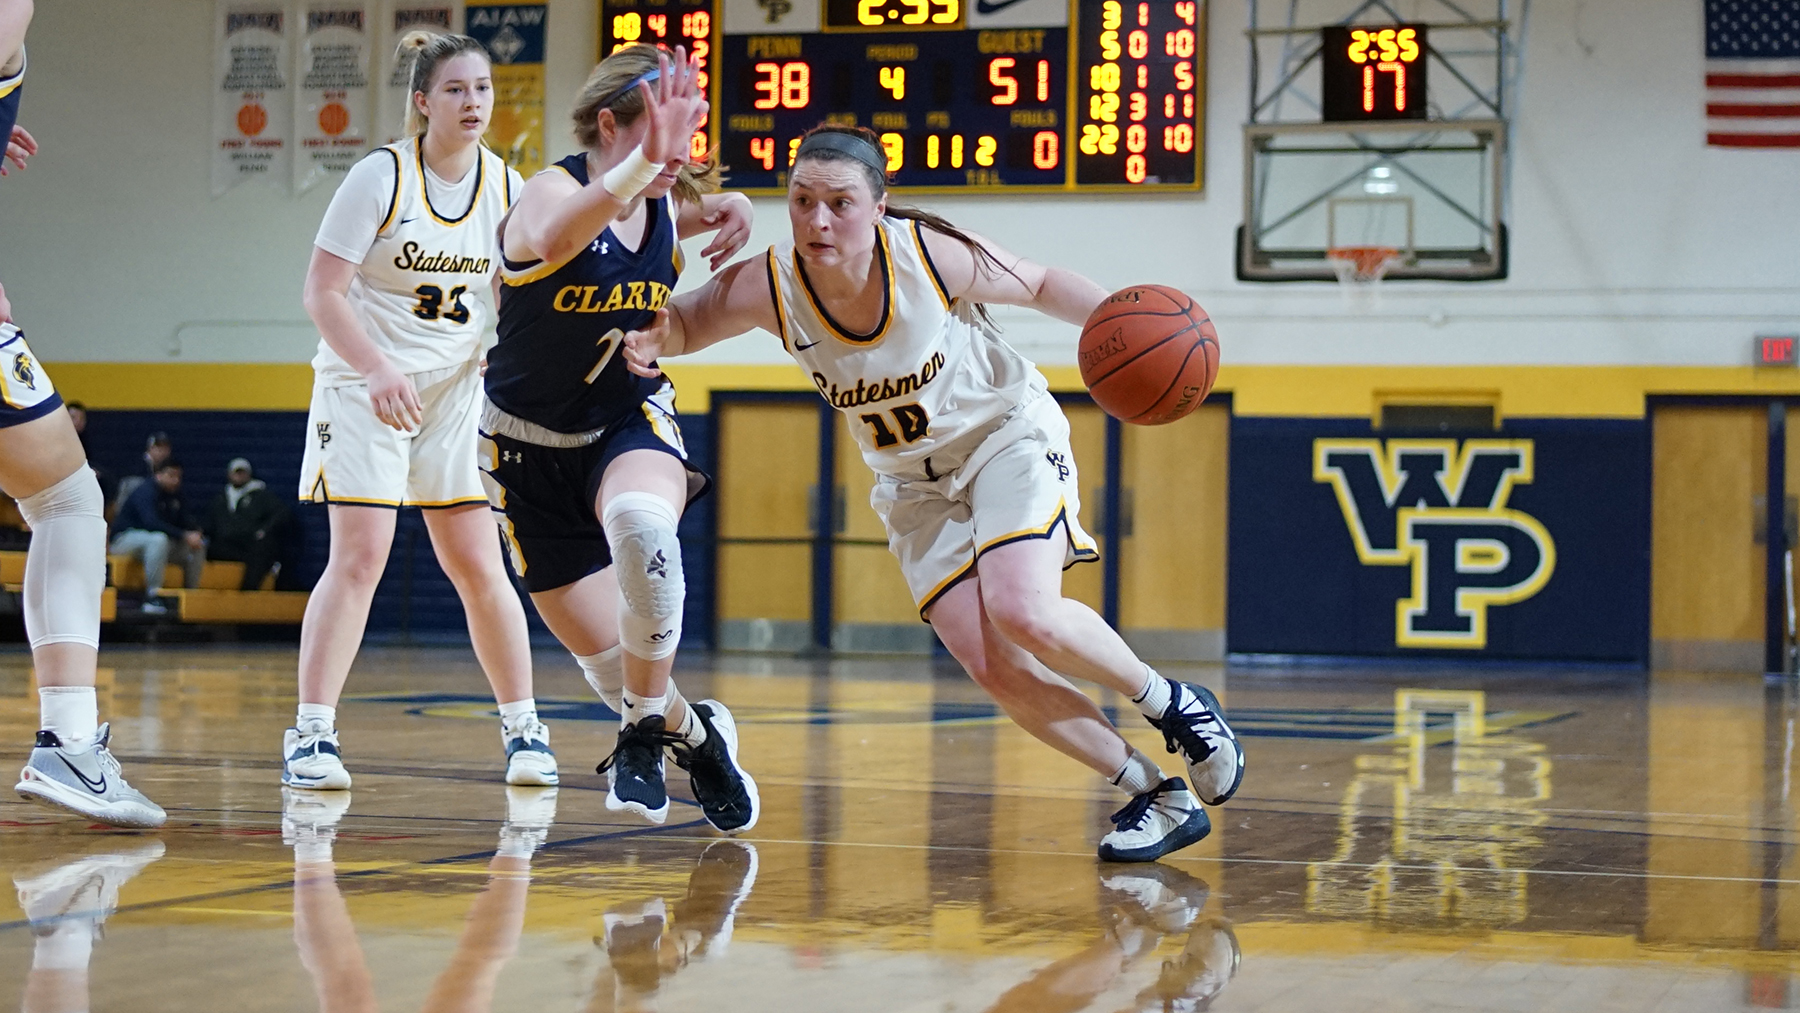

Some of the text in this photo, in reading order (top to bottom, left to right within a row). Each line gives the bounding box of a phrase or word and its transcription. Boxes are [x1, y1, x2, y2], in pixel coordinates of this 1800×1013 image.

[471, 9, 545, 27] AIAW
[613, 11, 710, 41] 10 4 10
[1102, 0, 1196, 30] 3 1 4
[977, 30, 1047, 54] GUEST
[1100, 28, 1195, 60] 5 0 10
[1347, 27, 1420, 64] 2:55
[755, 61, 811, 110] 38
[879, 66, 906, 100] 4
[989, 57, 1049, 105] 51
[1090, 61, 1194, 92] 10 1 5
[1362, 61, 1407, 112] 17
[1128, 92, 1148, 121] 3
[750, 137, 775, 170] 4
[975, 135, 997, 167] 2
[1033, 131, 1059, 170] 0
[1079, 123, 1194, 155] 22 0 10
[1126, 154, 1147, 184] 0
[393, 240, 491, 275] Statesmen
[812, 351, 945, 408] Statesmen
[858, 401, 933, 451] 10
[1313, 438, 1556, 649] WP
